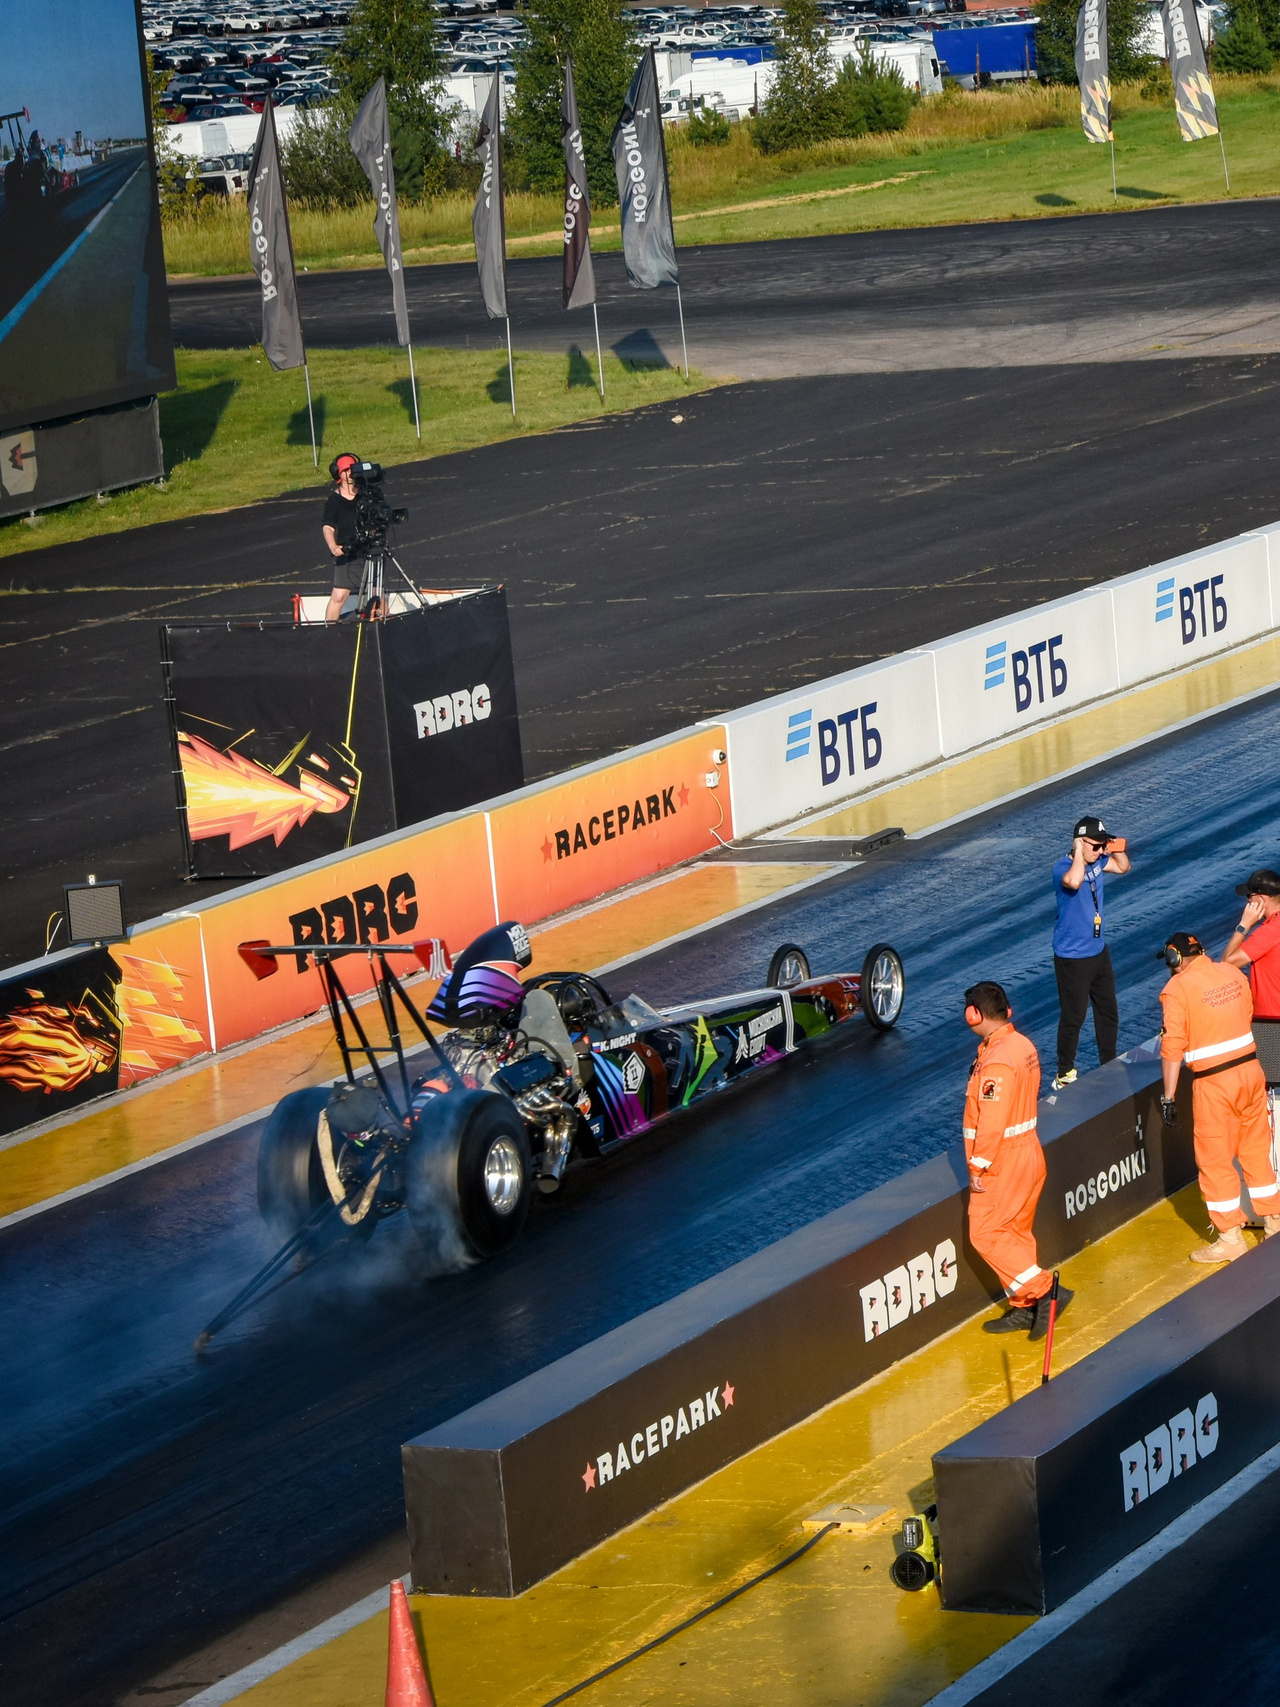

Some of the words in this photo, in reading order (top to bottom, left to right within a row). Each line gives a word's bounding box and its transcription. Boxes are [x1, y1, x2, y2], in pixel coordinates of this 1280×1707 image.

[1179, 574, 1227, 645] ВТБ
[413, 683, 492, 739] RDRC
[1011, 634, 1068, 713] ВТБ
[818, 702, 883, 786] ВТБ
[555, 785, 677, 860] RACEPARK
[289, 872, 418, 974] RDRC
[610, 1032, 637, 1050] NIGHT
[1064, 1148, 1147, 1220] ROSGONKI
[859, 1237, 958, 1343] RDRC
[596, 1386, 723, 1486] RACEPARK
[1119, 1392, 1220, 1512] RDRC
